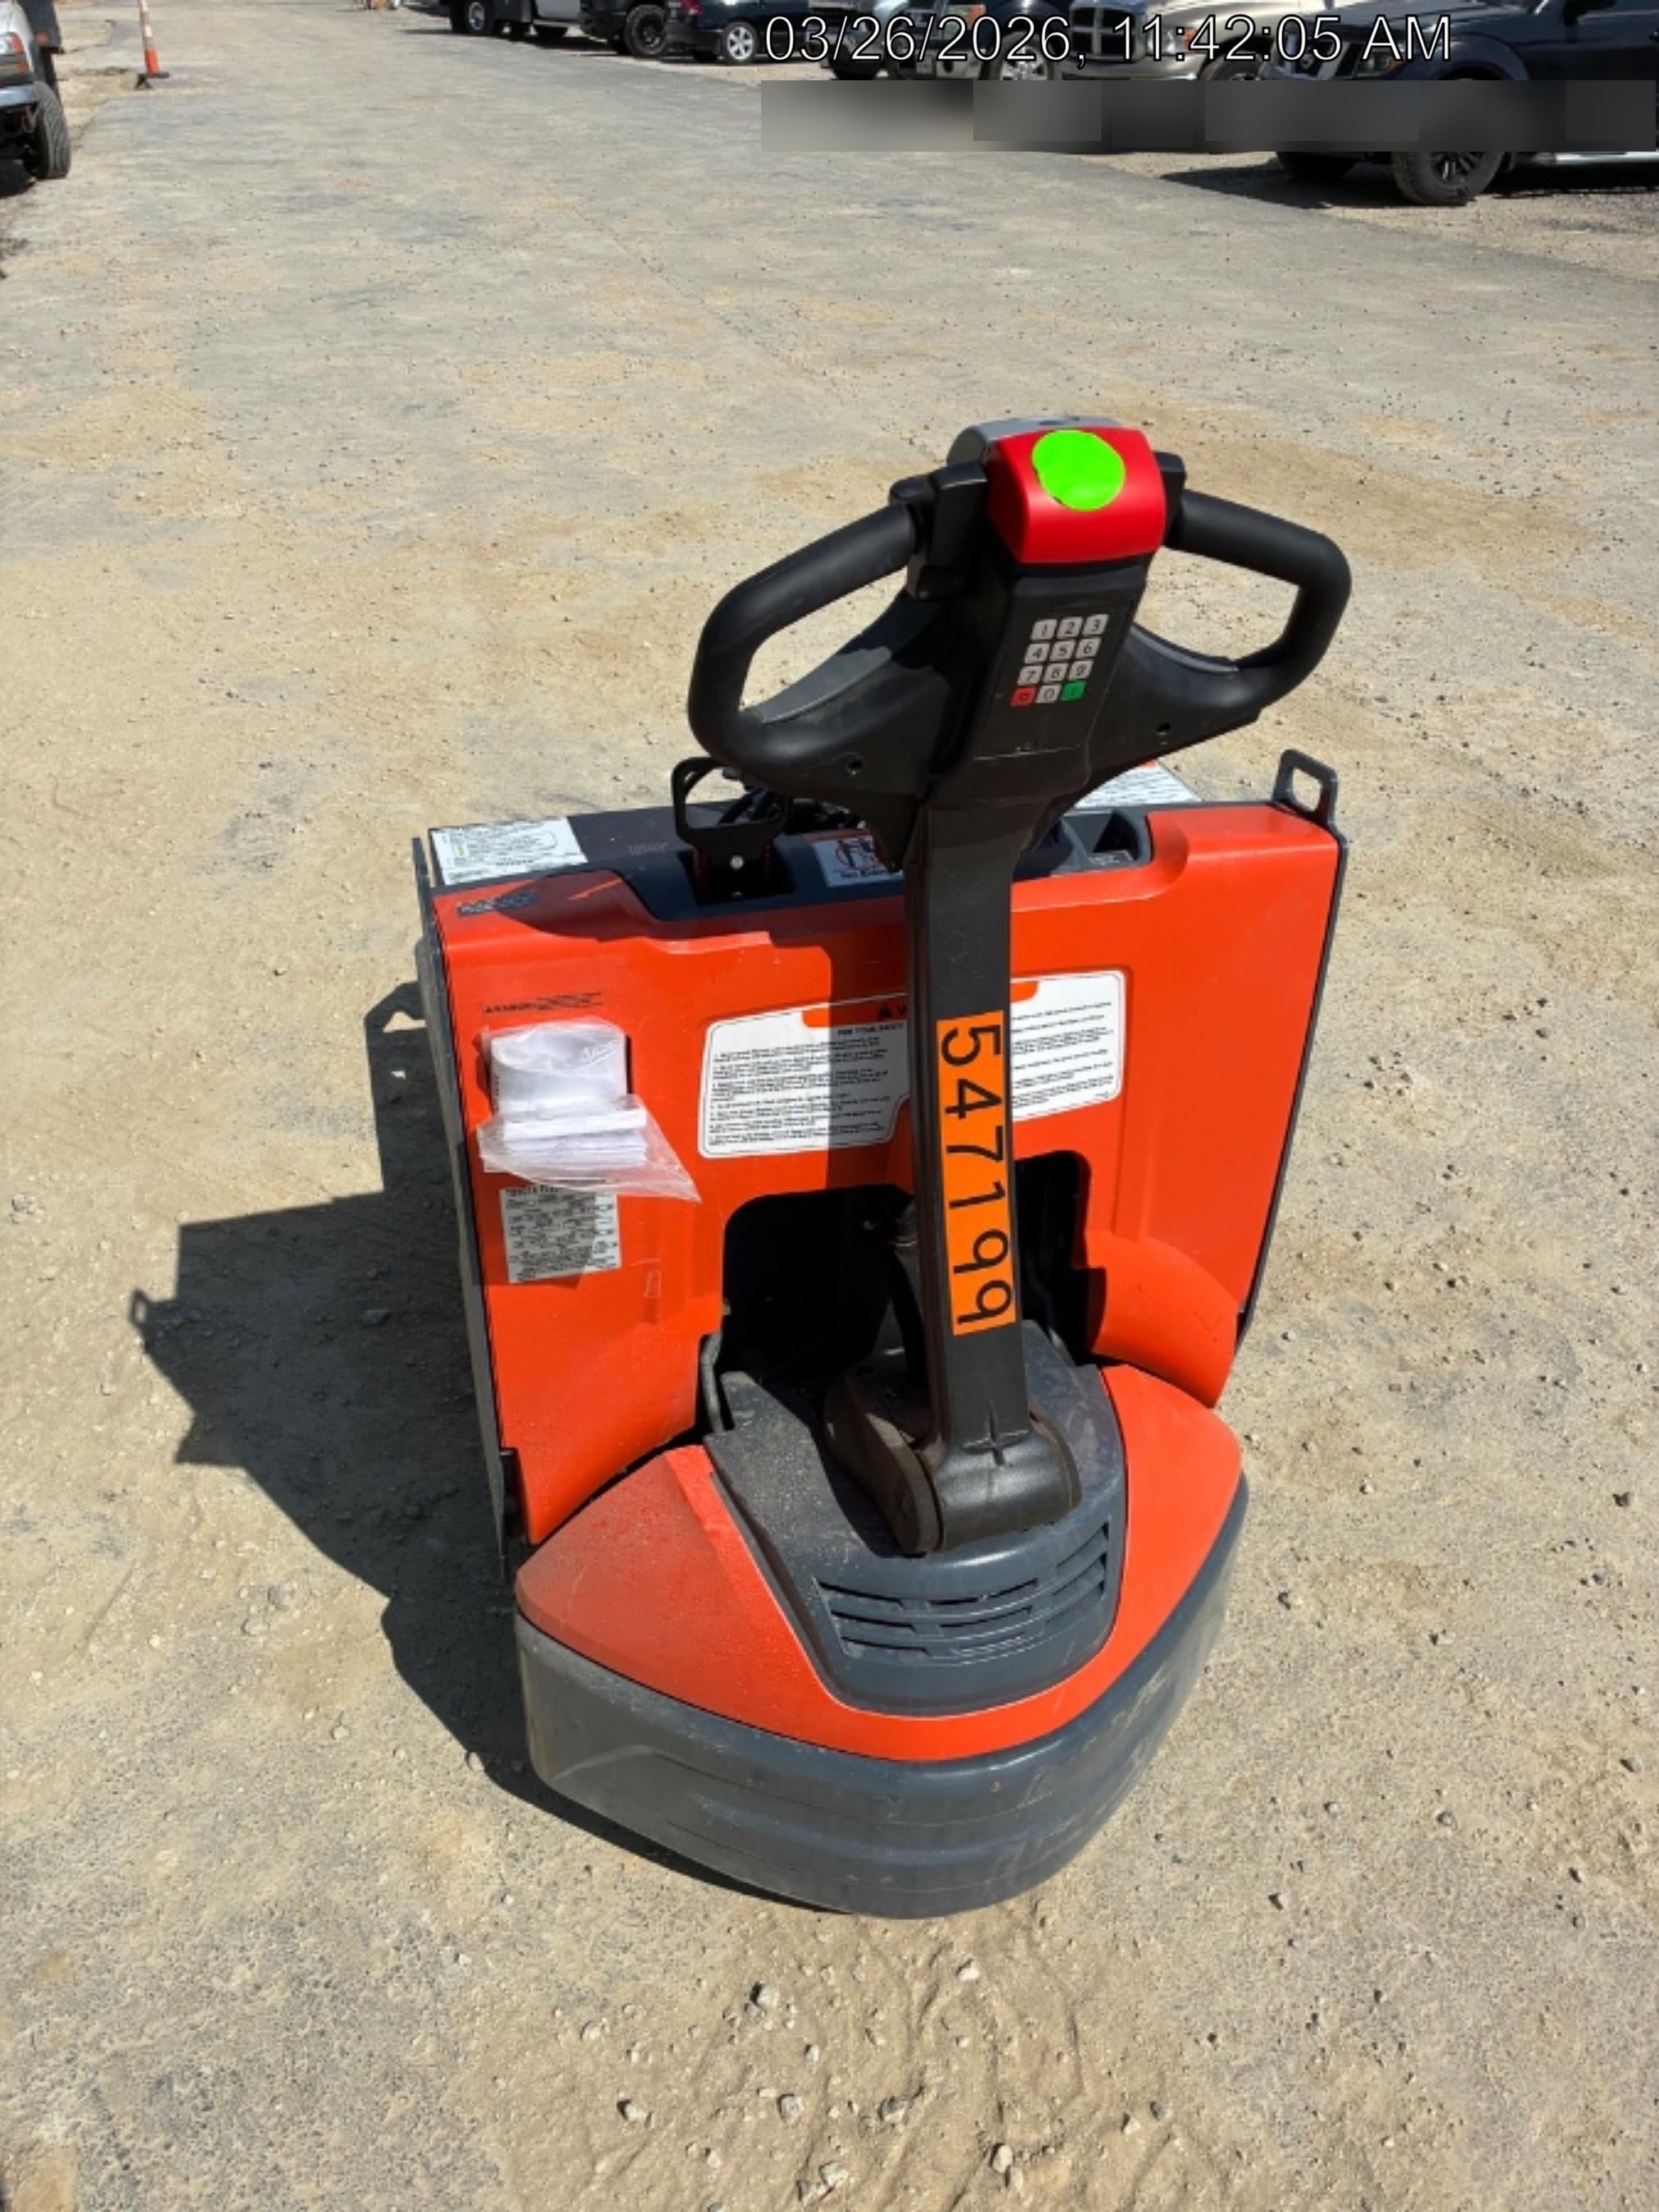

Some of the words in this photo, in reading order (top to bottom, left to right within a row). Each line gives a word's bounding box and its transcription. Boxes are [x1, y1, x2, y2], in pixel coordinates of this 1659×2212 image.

[1064, 621, 1076, 635] 2
[1090, 619, 1101, 632] 3
[1031, 646, 1042, 660] 4
[1057, 644, 1067, 656] 5
[1083, 641, 1093, 654] 6
[1027, 670, 1036, 682] 7
[941, 1025, 1013, 1324] 547199
